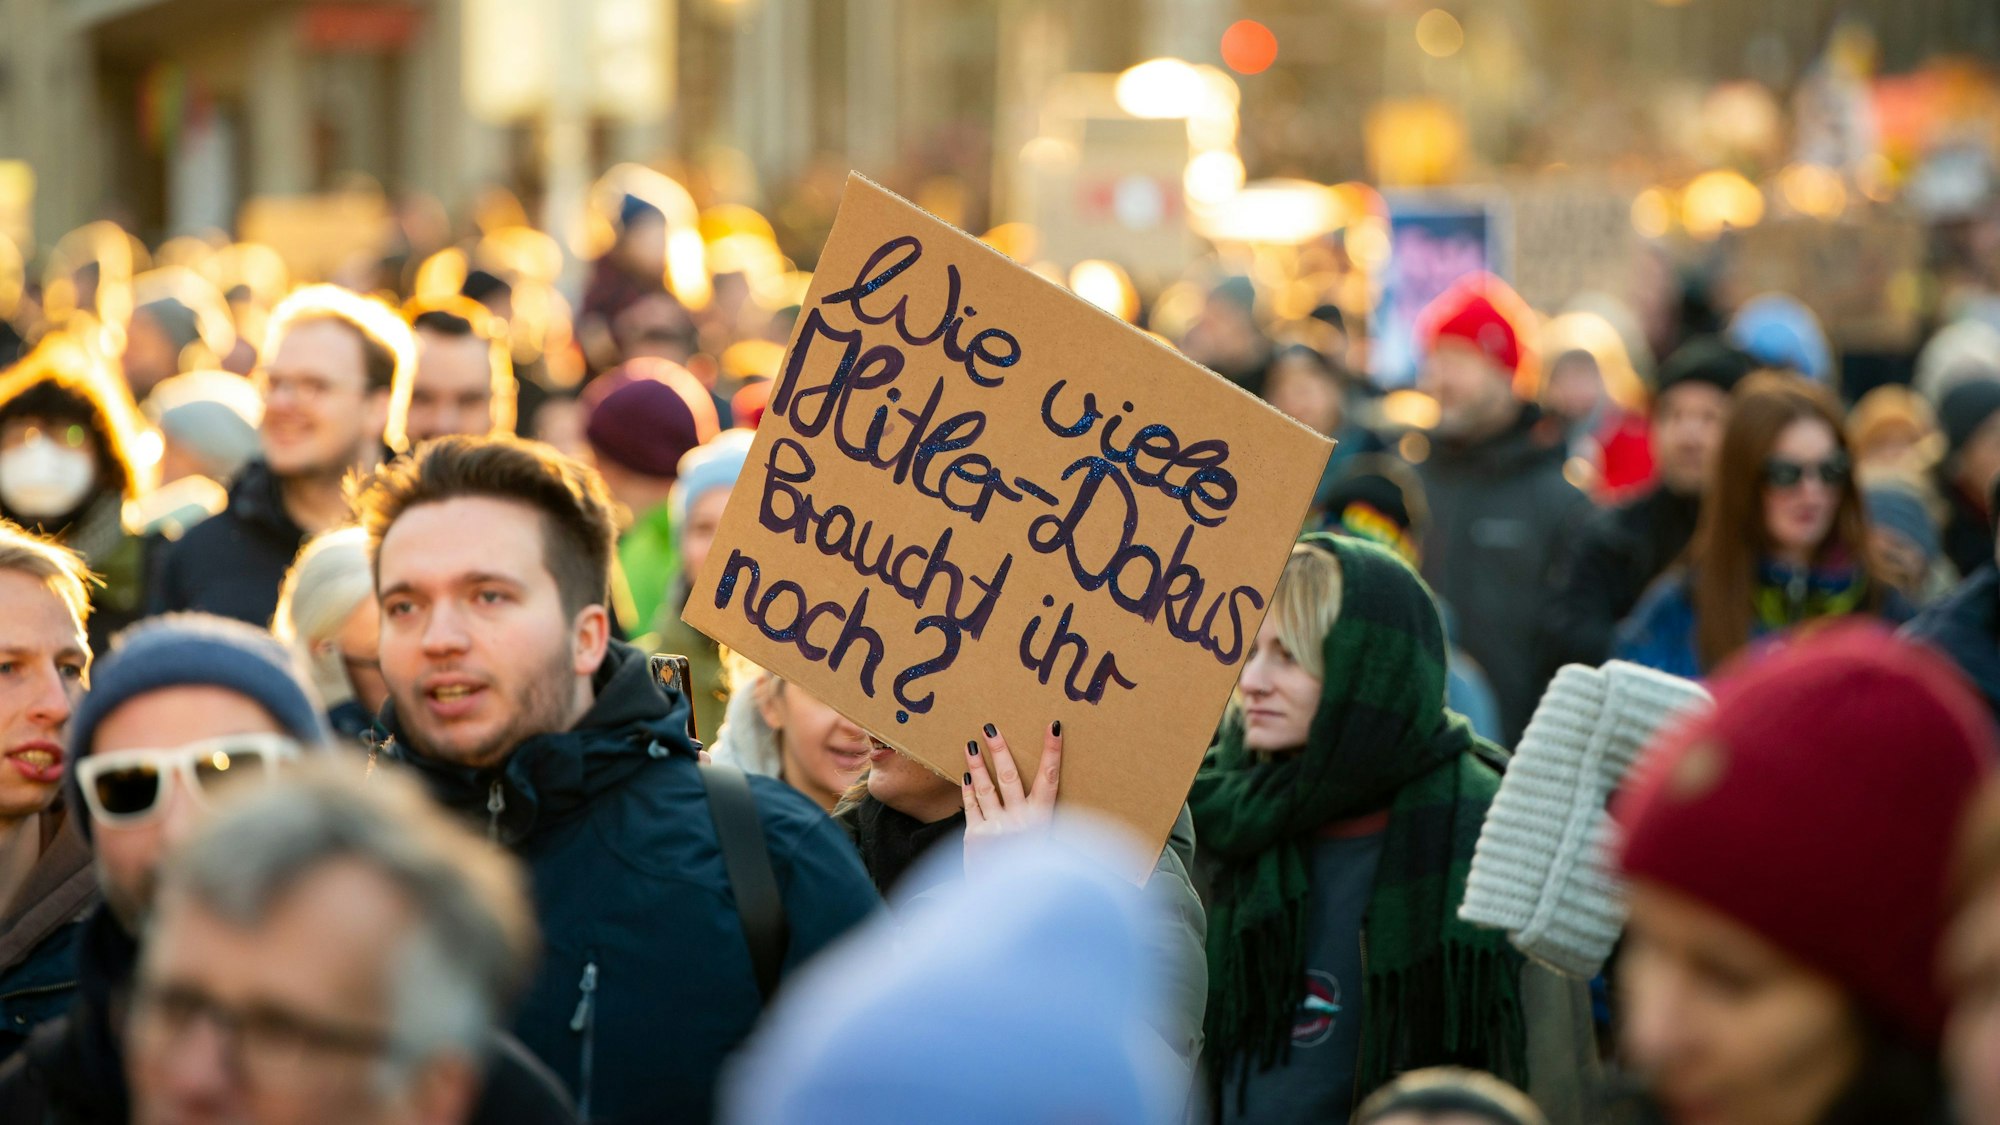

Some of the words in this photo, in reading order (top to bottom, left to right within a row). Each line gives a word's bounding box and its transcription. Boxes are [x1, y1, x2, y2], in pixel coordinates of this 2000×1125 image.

[773, 308, 1264, 664] Hitler-Dokus
[822, 236, 1022, 387] Wie
[1041, 380, 1238, 527] viele
[715, 549, 963, 724] noch?
[1020, 595, 1138, 705] ihr
